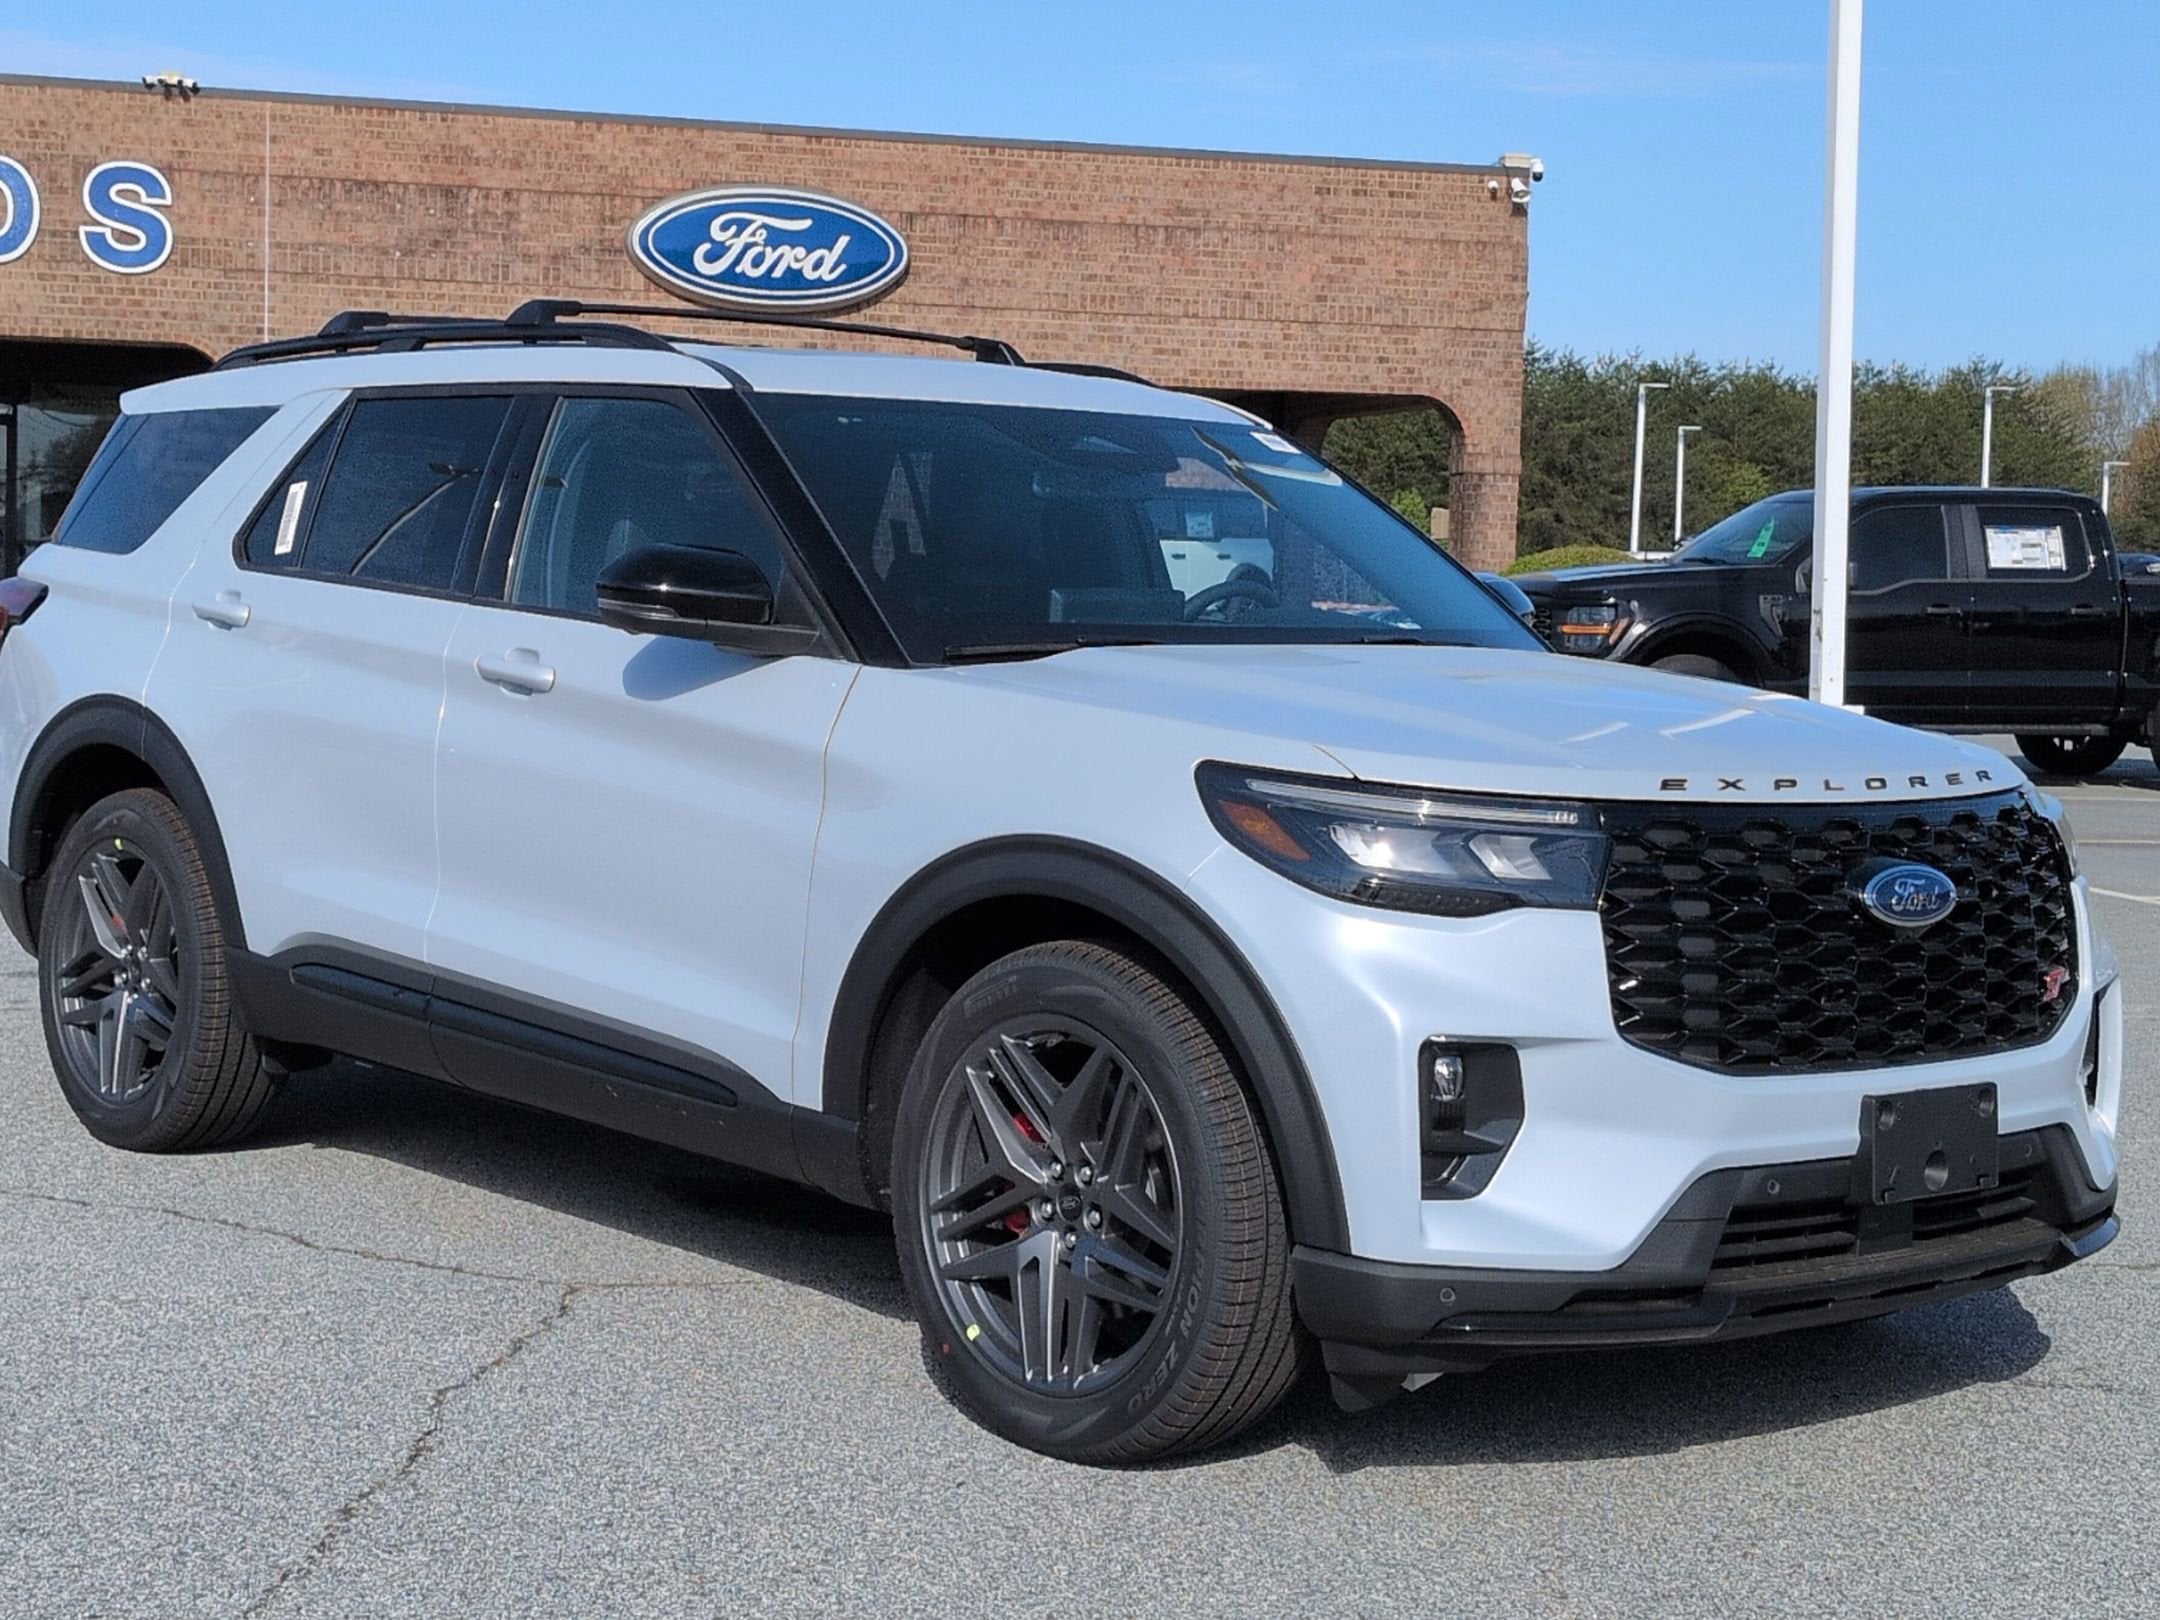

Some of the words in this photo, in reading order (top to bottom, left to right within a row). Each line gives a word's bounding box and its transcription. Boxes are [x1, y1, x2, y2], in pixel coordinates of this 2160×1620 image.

[693, 211, 852, 282] Ford
[1658, 769, 1993, 792] EXPLORER
[1890, 877, 1941, 912] Ford
